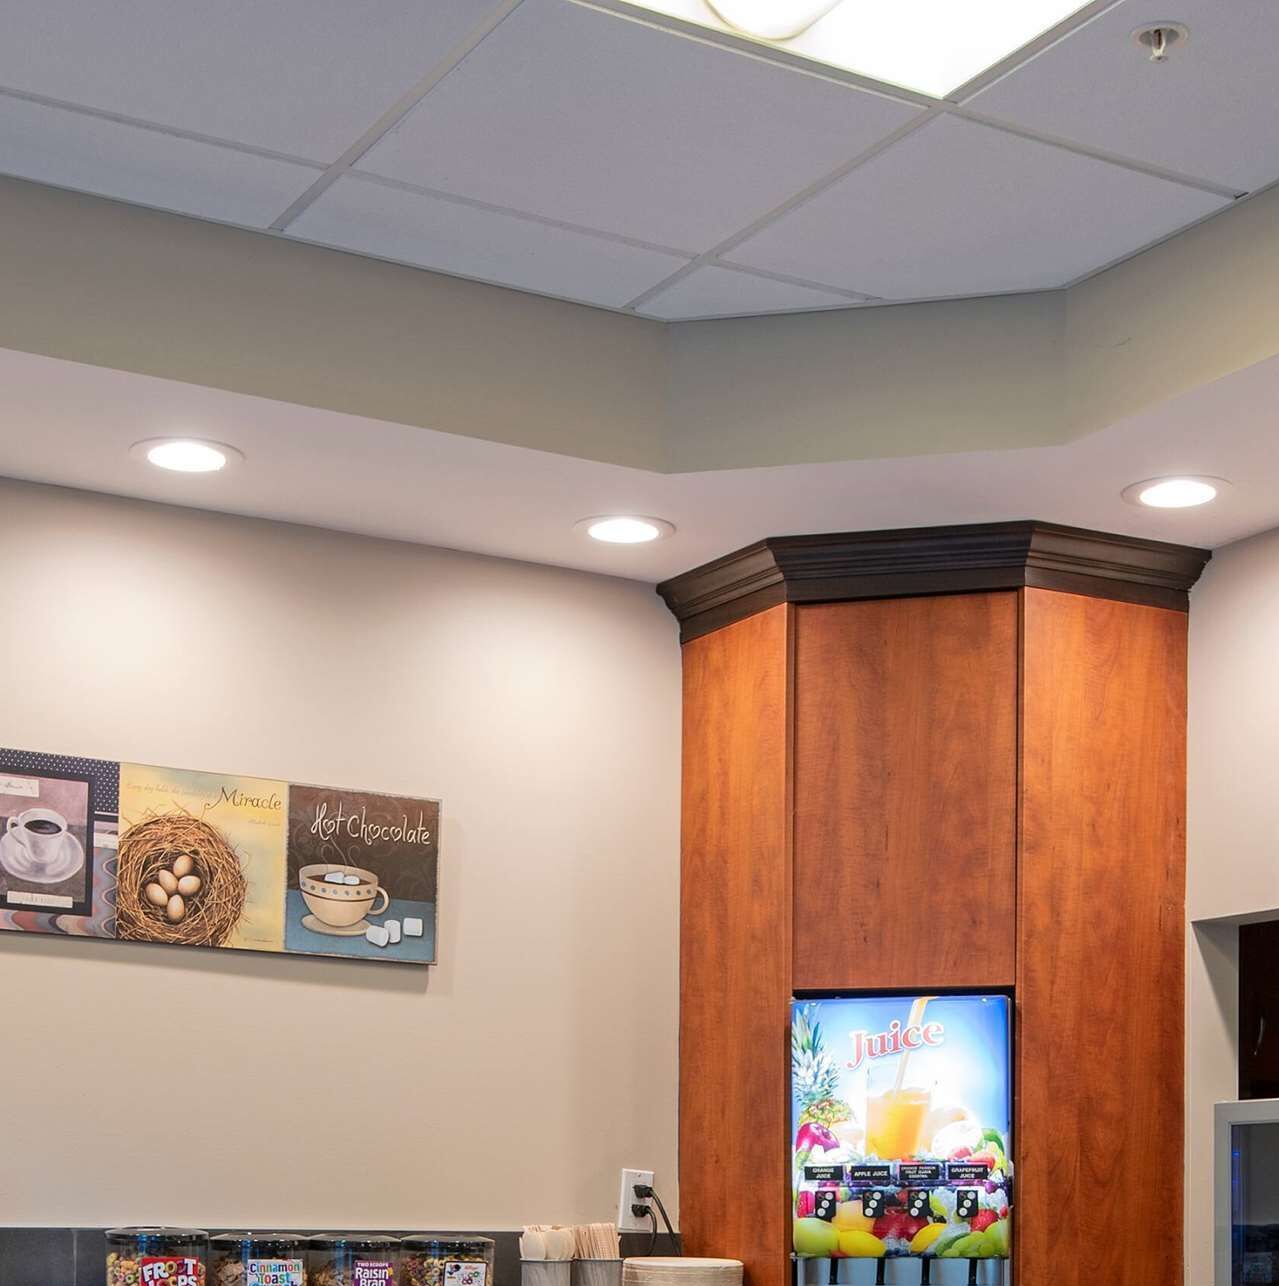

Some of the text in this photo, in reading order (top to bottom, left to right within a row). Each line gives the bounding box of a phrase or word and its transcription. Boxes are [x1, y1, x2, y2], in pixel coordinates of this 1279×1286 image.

[206, 784, 282, 811] Miracle
[310, 801, 432, 846] Hot Chocolate
[846, 1020, 944, 1070] Juice
[141, 1258, 197, 1282] FROOT
[249, 1262, 300, 1274] Cinnamon
[256, 1272, 291, 1284] Toast
[355, 1267, 389, 1279] Raisin
